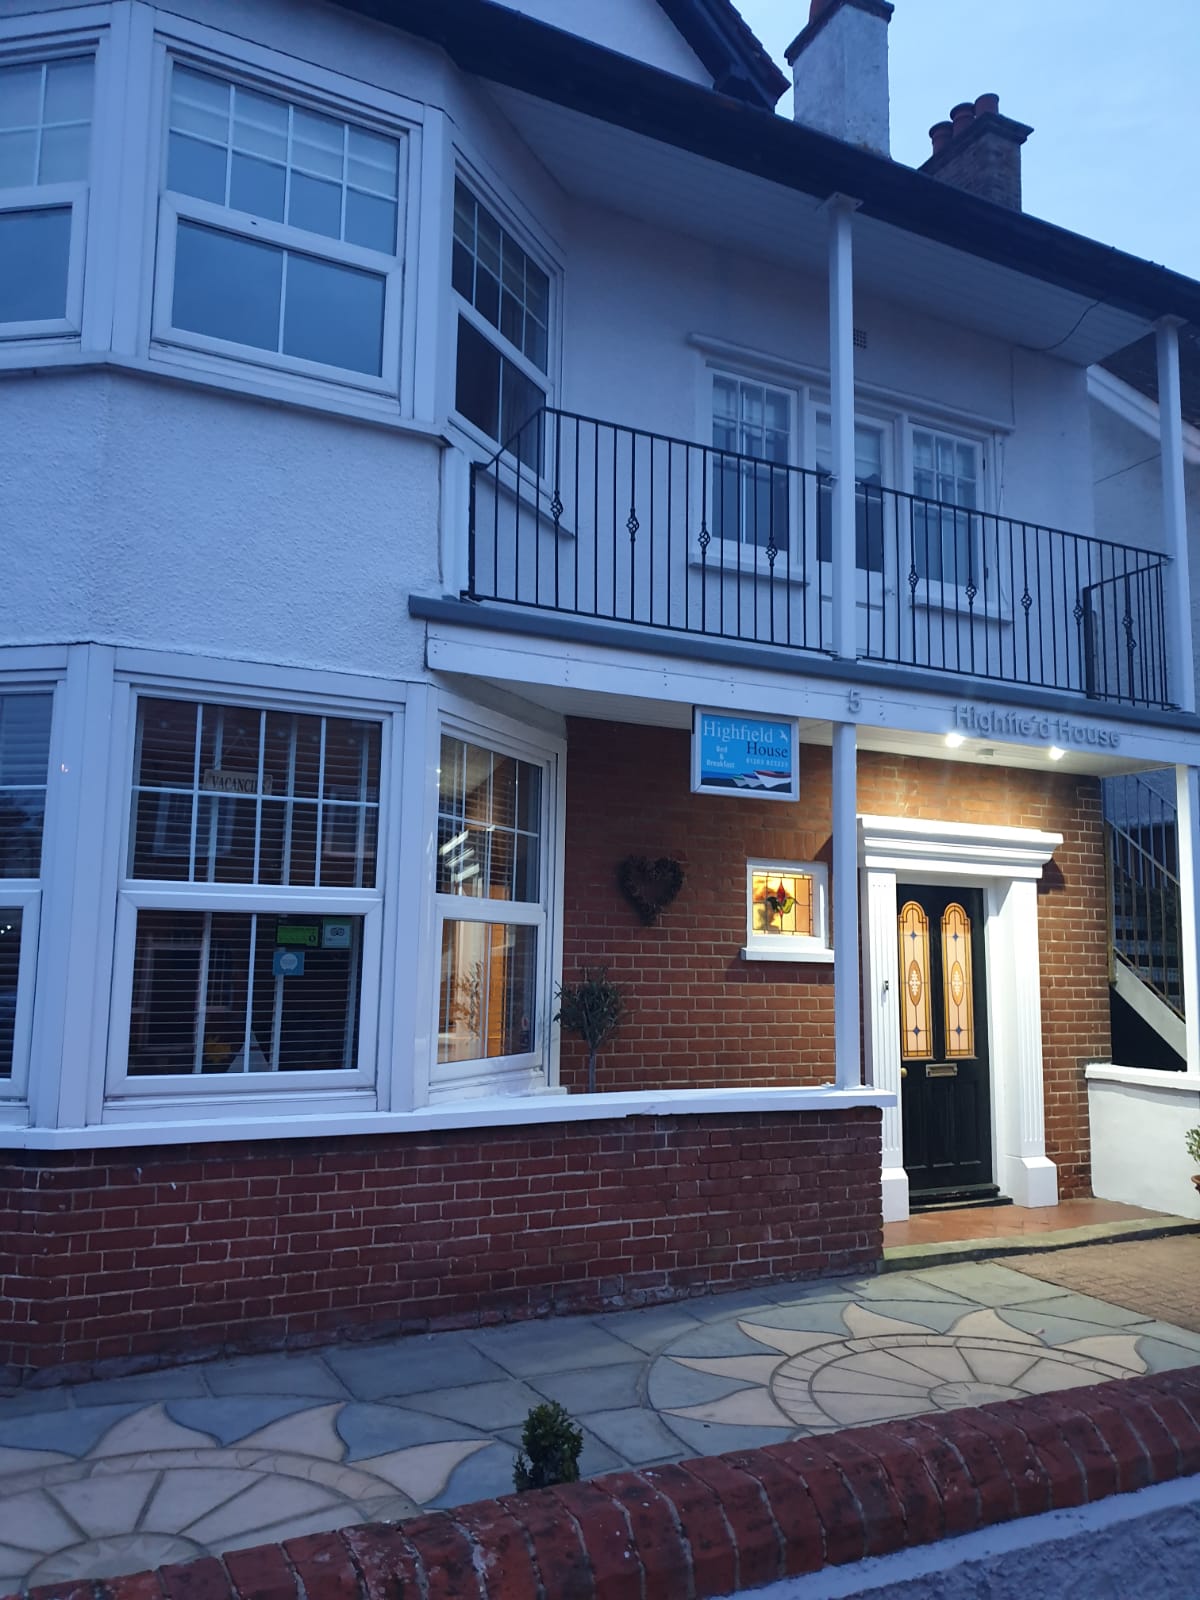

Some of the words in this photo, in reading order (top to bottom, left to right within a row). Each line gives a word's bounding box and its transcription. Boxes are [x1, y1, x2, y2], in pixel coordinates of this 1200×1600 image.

[848, 687, 861, 714] 5
[703, 720, 773, 744] Highfield
[1056, 718, 1121, 748] House
[715, 745, 728, 753] Bed
[746, 741, 788, 758] House
[706, 759, 735, 768] Breakfast
[212, 775, 265, 793] VACANCI
